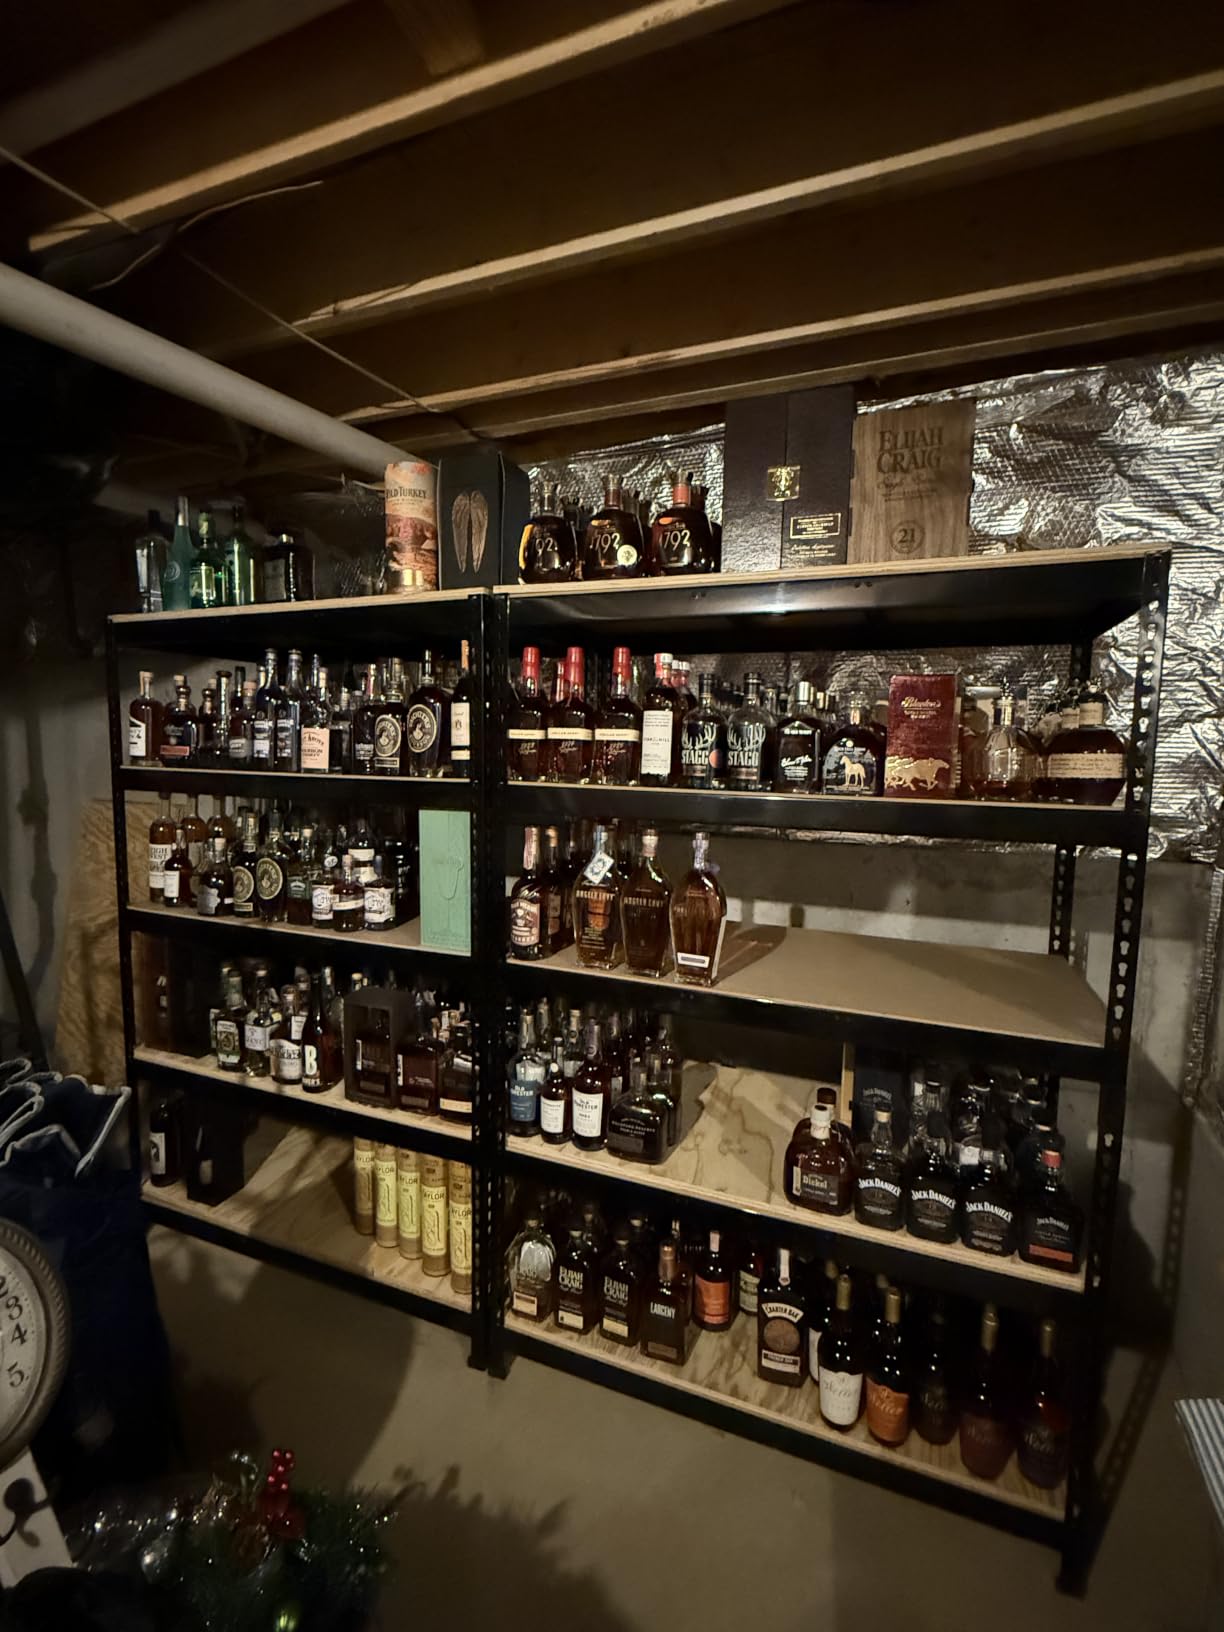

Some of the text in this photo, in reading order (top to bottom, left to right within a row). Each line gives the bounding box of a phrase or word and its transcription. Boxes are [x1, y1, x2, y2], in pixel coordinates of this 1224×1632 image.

[879, 428, 944, 451] ELIJAH
[877, 448, 941, 473] CRAIG
[898, 528, 916, 543] 21
[858, 1178, 875, 1190] JACK
[911, 1189, 929, 1201] JACK
[965, 1200, 984, 1213] JACK
[6, 1295, 24, 1321] 3
[650, 1301, 677, 1320] LARCENY
[11, 1323, 28, 1346] 4
[7, 1361, 26, 1388] 5
